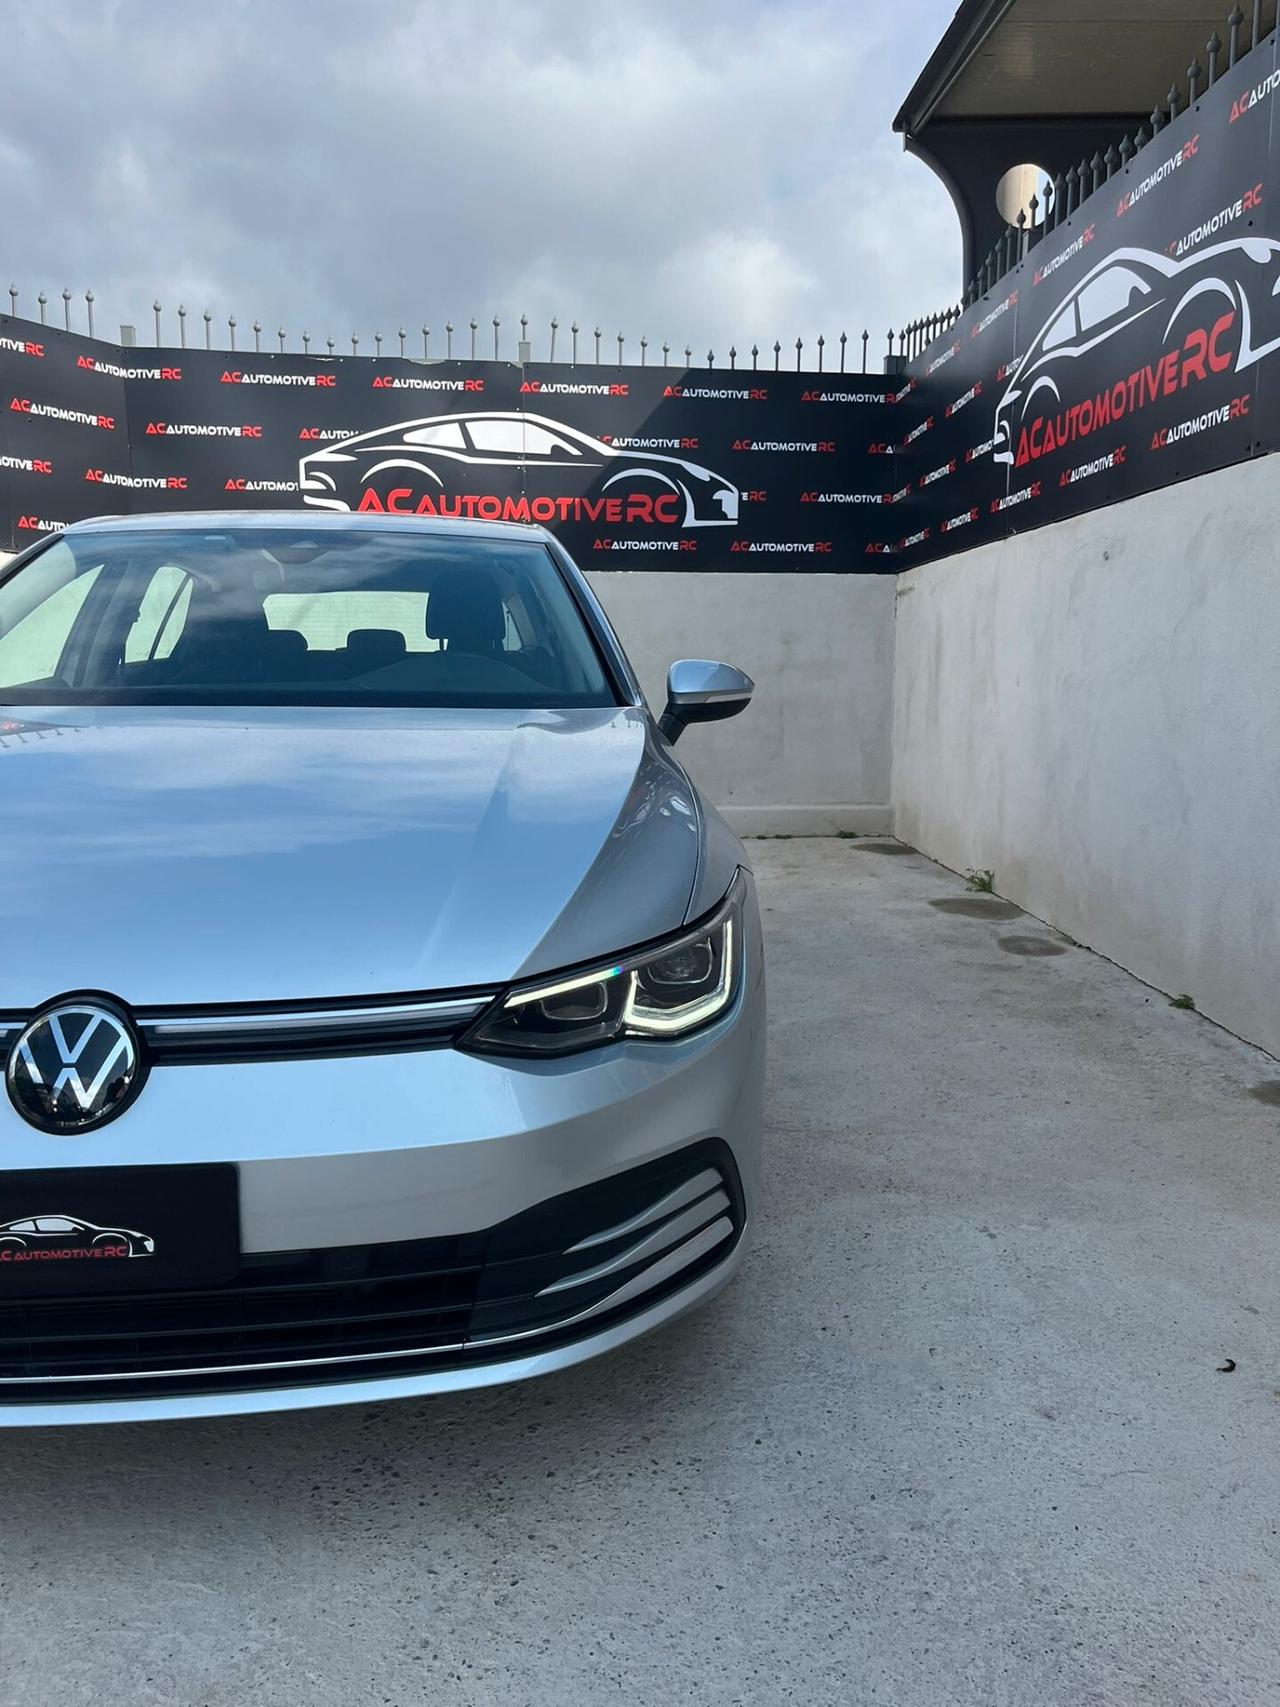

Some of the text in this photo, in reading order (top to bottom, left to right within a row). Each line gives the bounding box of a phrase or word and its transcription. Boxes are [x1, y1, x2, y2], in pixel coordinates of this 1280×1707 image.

[1116, 134, 1199, 218] ACAUTOMOTIVERC
[1169, 183, 1263, 256] CAUTOMOTIVERC
[0, 338, 45, 356] TIVERC
[77, 355, 182, 380] ACAUTOMOTIVERC
[220, 371, 336, 387] ACAUTOMOTIVERC
[372, 376, 484, 391] ACAUTOMOTIVERC
[520, 381, 629, 396] ACAUTOMOTIVERC
[663, 384, 768, 400] ACAUTOMOTIVERC
[1015, 311, 1236, 467] ACAUTOMOTIVERC
[10, 398, 115, 430] ACAUTOMOTIVERC
[1151, 394, 1250, 450] ACAUTOMOTIVERC
[146, 422, 262, 438] ACAUTOMOTIVERC
[601, 434, 699, 449] CAUTOMOTIVERC
[732, 439, 836, 452] ACAUTOMOTIVERC
[868, 443, 896, 454] ACA
[0, 456, 52, 474] OTIVERC
[1060, 445, 1127, 486] ACAUTOMOTIVERC
[86, 469, 188, 489] ACAUTOMOTIVERC
[357, 487, 680, 524] ACAUTOMOTIVERC
[18, 516, 69, 531] ACAUTO
[593, 538, 697, 551] ACAUTOMOTIVERC
[730, 540, 832, 552] ACAUTOMOTIVERC
